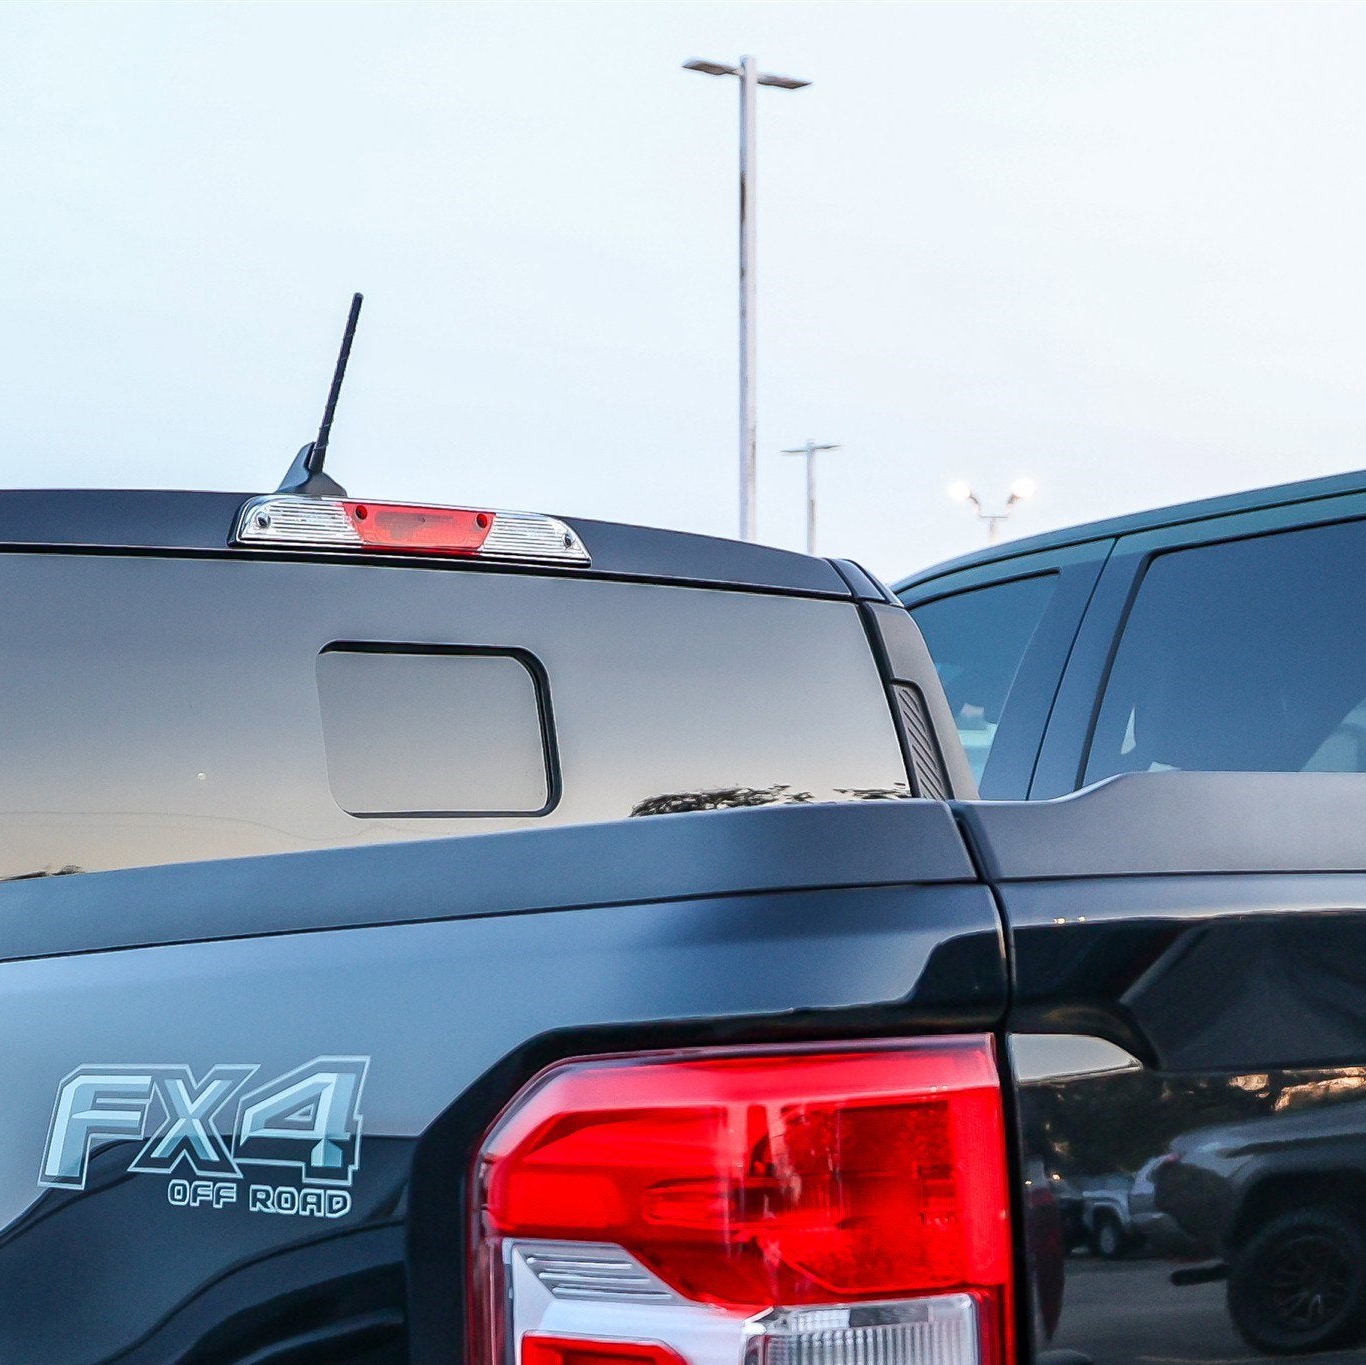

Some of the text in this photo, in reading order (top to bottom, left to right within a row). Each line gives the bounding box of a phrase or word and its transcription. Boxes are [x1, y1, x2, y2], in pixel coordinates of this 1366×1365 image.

[37, 1055, 371, 1190] FX4
[168, 1178, 352, 1218] OFF ROAD
